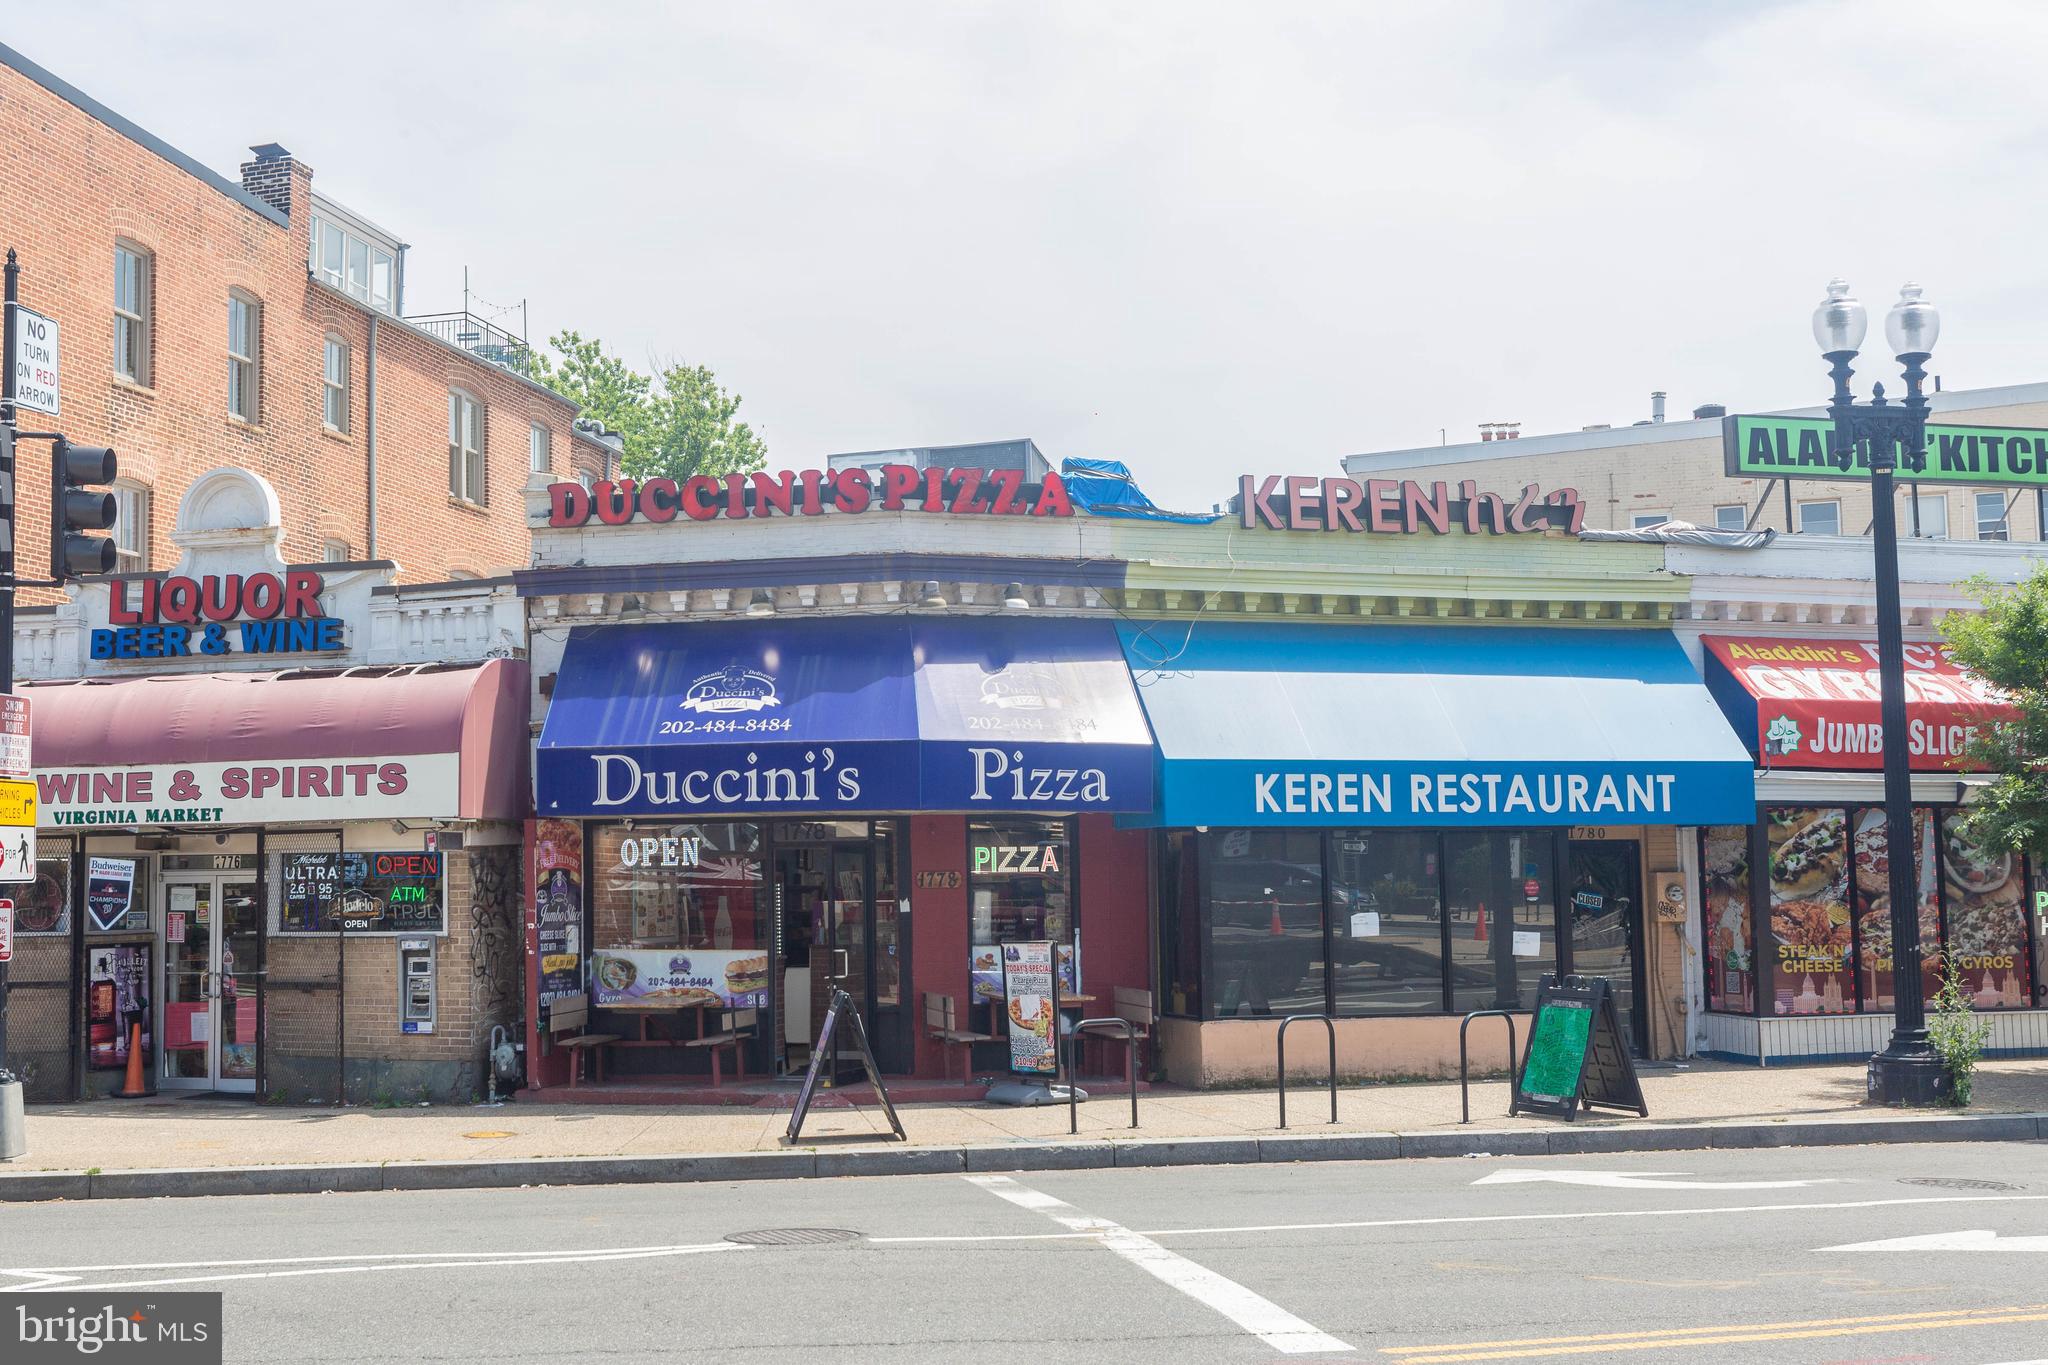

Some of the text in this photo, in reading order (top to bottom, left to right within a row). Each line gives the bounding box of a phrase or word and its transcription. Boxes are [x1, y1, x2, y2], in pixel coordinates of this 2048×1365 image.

[27, 319, 46, 341] NO
[23, 342, 50, 364] TURN
[17, 362, 56, 387] ON RED
[18, 385, 54, 407] ARROW
[547, 464, 1076, 528] DUCCINI'S PIZZA
[1239, 474, 1450, 535] KEREN
[109, 571, 327, 626] LIQUOR
[90, 617, 345, 660] BEER & WINE
[1727, 641, 1863, 664] Aladdin's
[699, 685, 765, 699] Duccini's
[5, 700, 25, 712] SNOW
[711, 699, 748, 709] PIZZA
[5, 721, 24, 734] ROUTE
[658, 718, 792, 734] 202-484-8484
[1810, 717, 1883, 754] JUMB
[36, 762, 409, 805] WINE & SPIRITS
[591, 747, 1111, 806] Duccini's Pizza
[1256, 773, 1677, 814] KEREN RESTAURANT
[53, 807, 224, 825] VIRGINIA MARKET
[782, 824, 826, 840] 1778
[1569, 828, 1606, 839] 1780
[5, 849, 17, 860] FOR
[620, 837, 700, 867] OPEN
[974, 846, 1060, 873] PIZZA
[91, 859, 133, 872] Budweiser
[376, 855, 437, 874] OPEN
[554, 853, 580, 868] DELIVERY
[285, 866, 340, 880] ULTRA
[289, 882, 333, 894] 2.6 95
[390, 885, 425, 902] ATM
[89, 895, 128, 905] CHAMPIONS
[1578, 893, 1602, 906] CLOSED
[389, 903, 443, 920] TRULY
[538, 903, 582, 929] Jumbo Slice
[344, 919, 369, 929] OPEN
[1778, 944, 1829, 958] STEAK
[1006, 964, 1028, 973] TODAY'S
[1782, 959, 1843, 973] CHEESE
[1962, 956, 2014, 969] GYROS
[1014, 1055, 1037, 1068] $10.99
